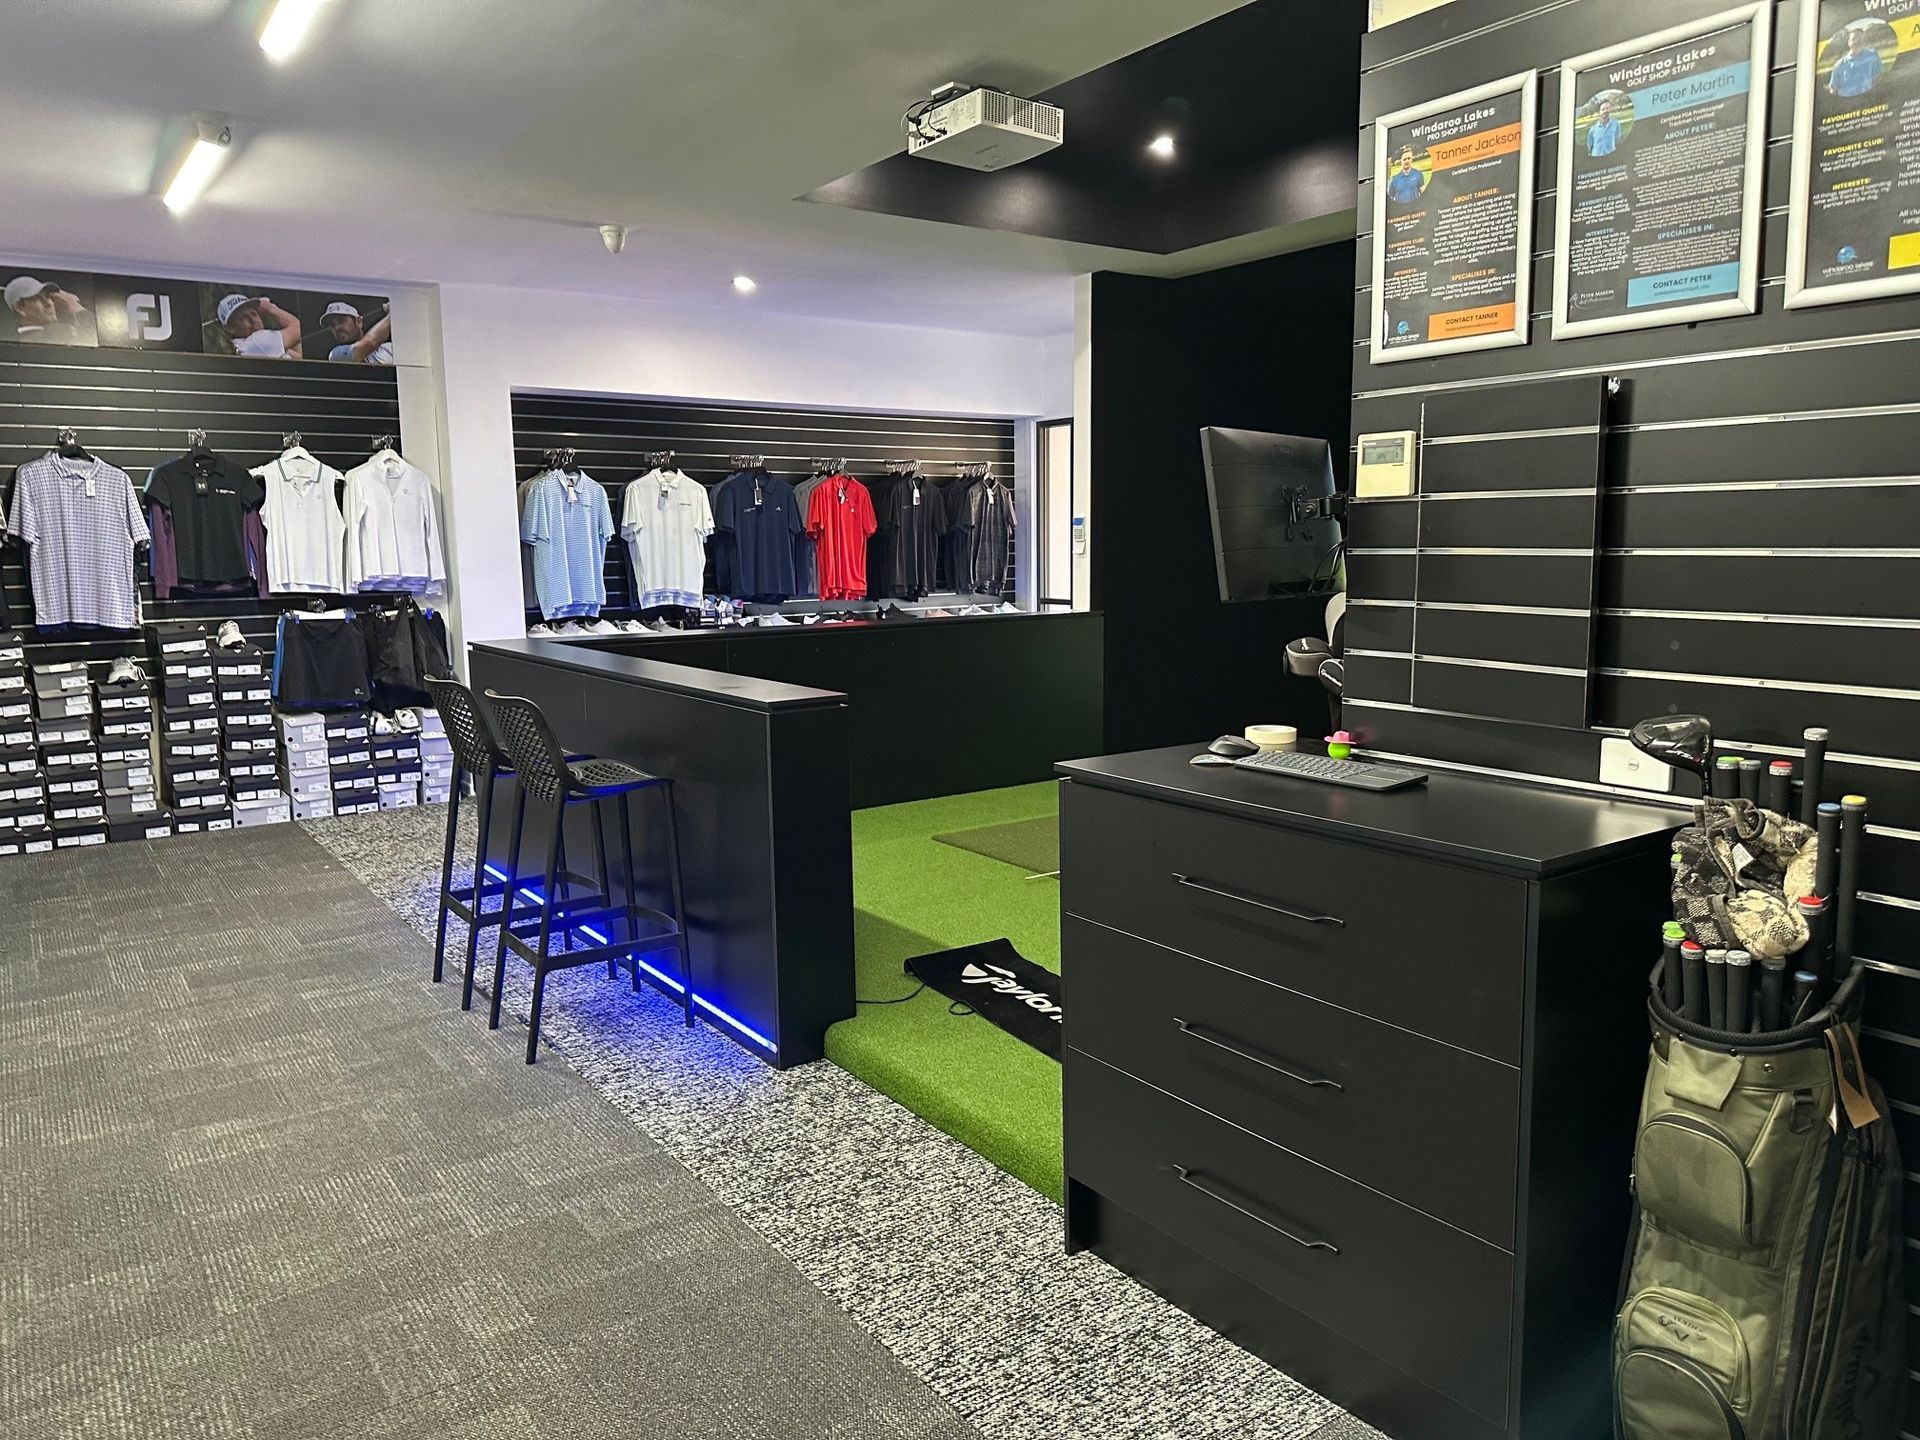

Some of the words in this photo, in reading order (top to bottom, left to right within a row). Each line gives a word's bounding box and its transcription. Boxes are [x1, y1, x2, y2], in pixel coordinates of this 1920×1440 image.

[1609, 59, 1672, 83] Windaroo
[1677, 46, 1715, 64] Lakes
[1627, 75, 1647, 87] GOLF
[1649, 69, 1670, 81] SHOP
[1672, 62, 1695, 75] STAFF
[1651, 85, 1688, 106] Peter
[1690, 72, 1736, 96] Martin
[1412, 118, 1461, 137] Windaroo
[1464, 108, 1495, 123] Lakes
[1823, 111, 1860, 124] FAVOURITE
[1427, 132, 1440, 141] PRO
[1441, 127, 1458, 137] SHOP
[1460, 121, 1478, 132] STAFF
[1664, 128, 1689, 140] ABOUT
[1436, 144, 1472, 160] Tanner
[1475, 131, 1521, 151] Jackson
[1824, 143, 1861, 156] FAVOURITE
[1453, 194, 1472, 203] ABOUT
[1658, 226, 1701, 240] SPECIALISES
[1653, 278, 1688, 288] CONTACT
[1690, 275, 1711, 283] PETER
[126, 292, 173, 341] FJ
[1446, 316, 1473, 324] CONTACT
[1475, 312, 1498, 320] TANNER
